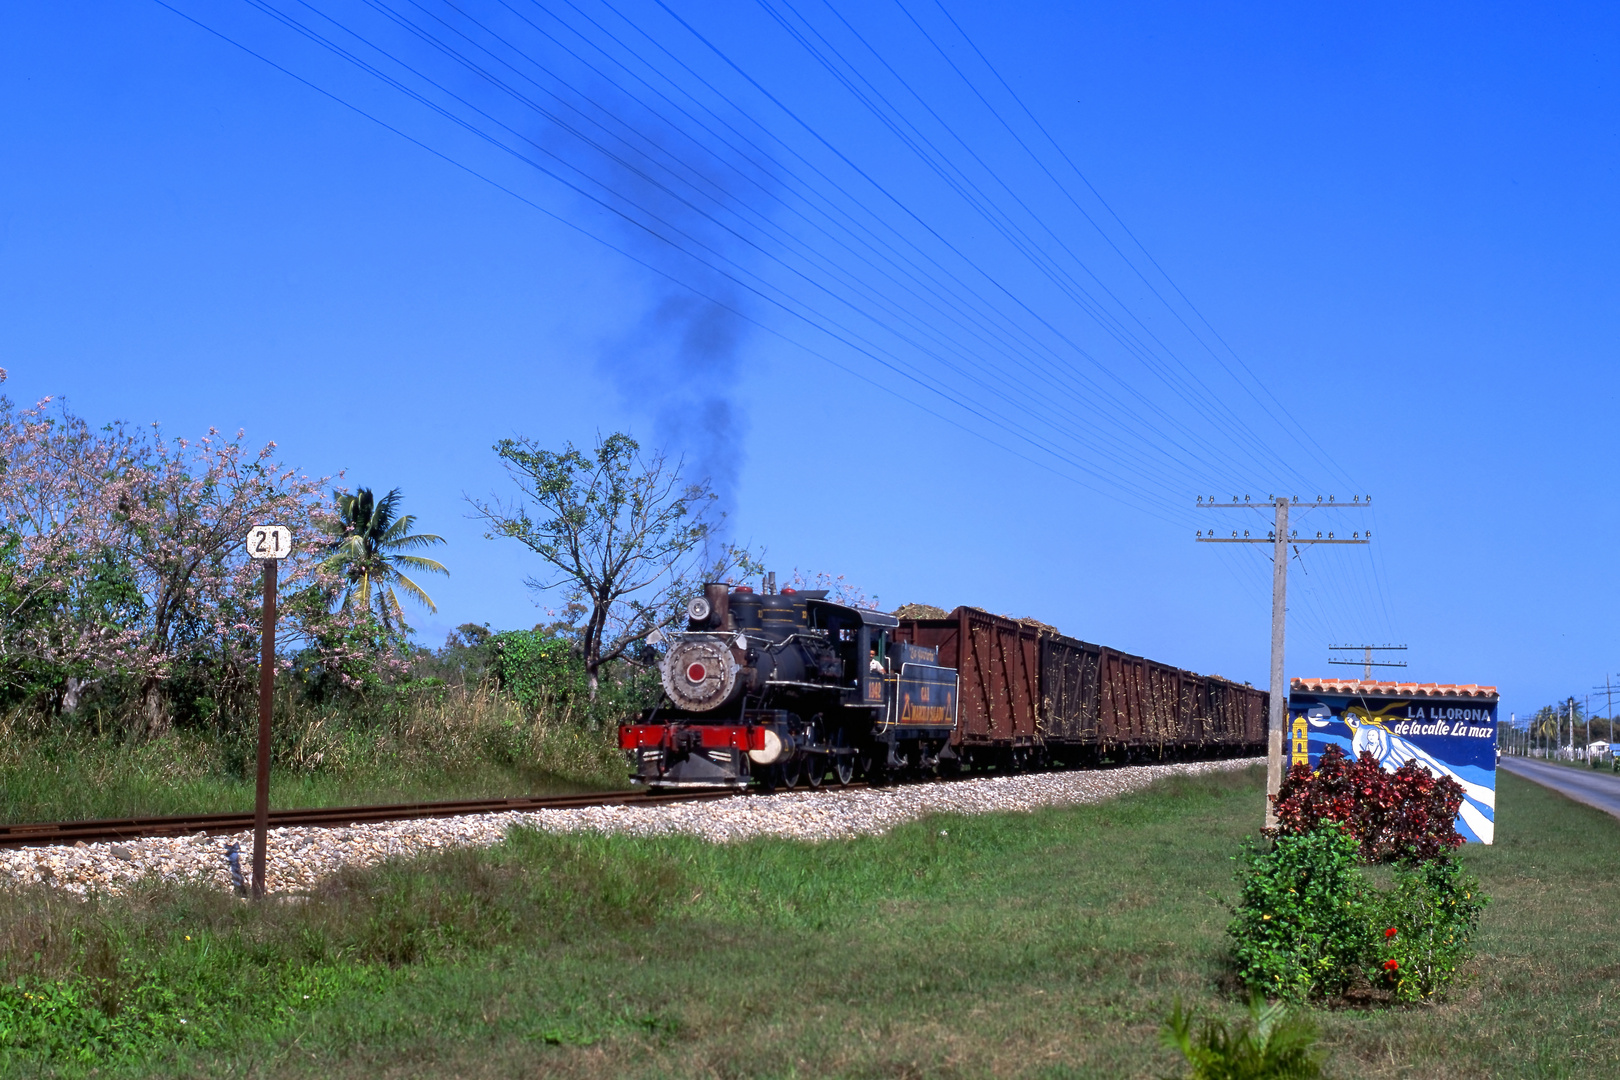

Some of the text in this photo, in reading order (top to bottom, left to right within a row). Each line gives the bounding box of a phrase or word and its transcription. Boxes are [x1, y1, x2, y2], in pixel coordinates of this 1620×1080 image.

[255, 530, 279, 552] 21
[1407, 706, 1491, 722] LA LLORONA
[1394, 721, 1409, 735] de
[1409, 721, 1421, 735] la
[1421, 719, 1450, 735] calle
